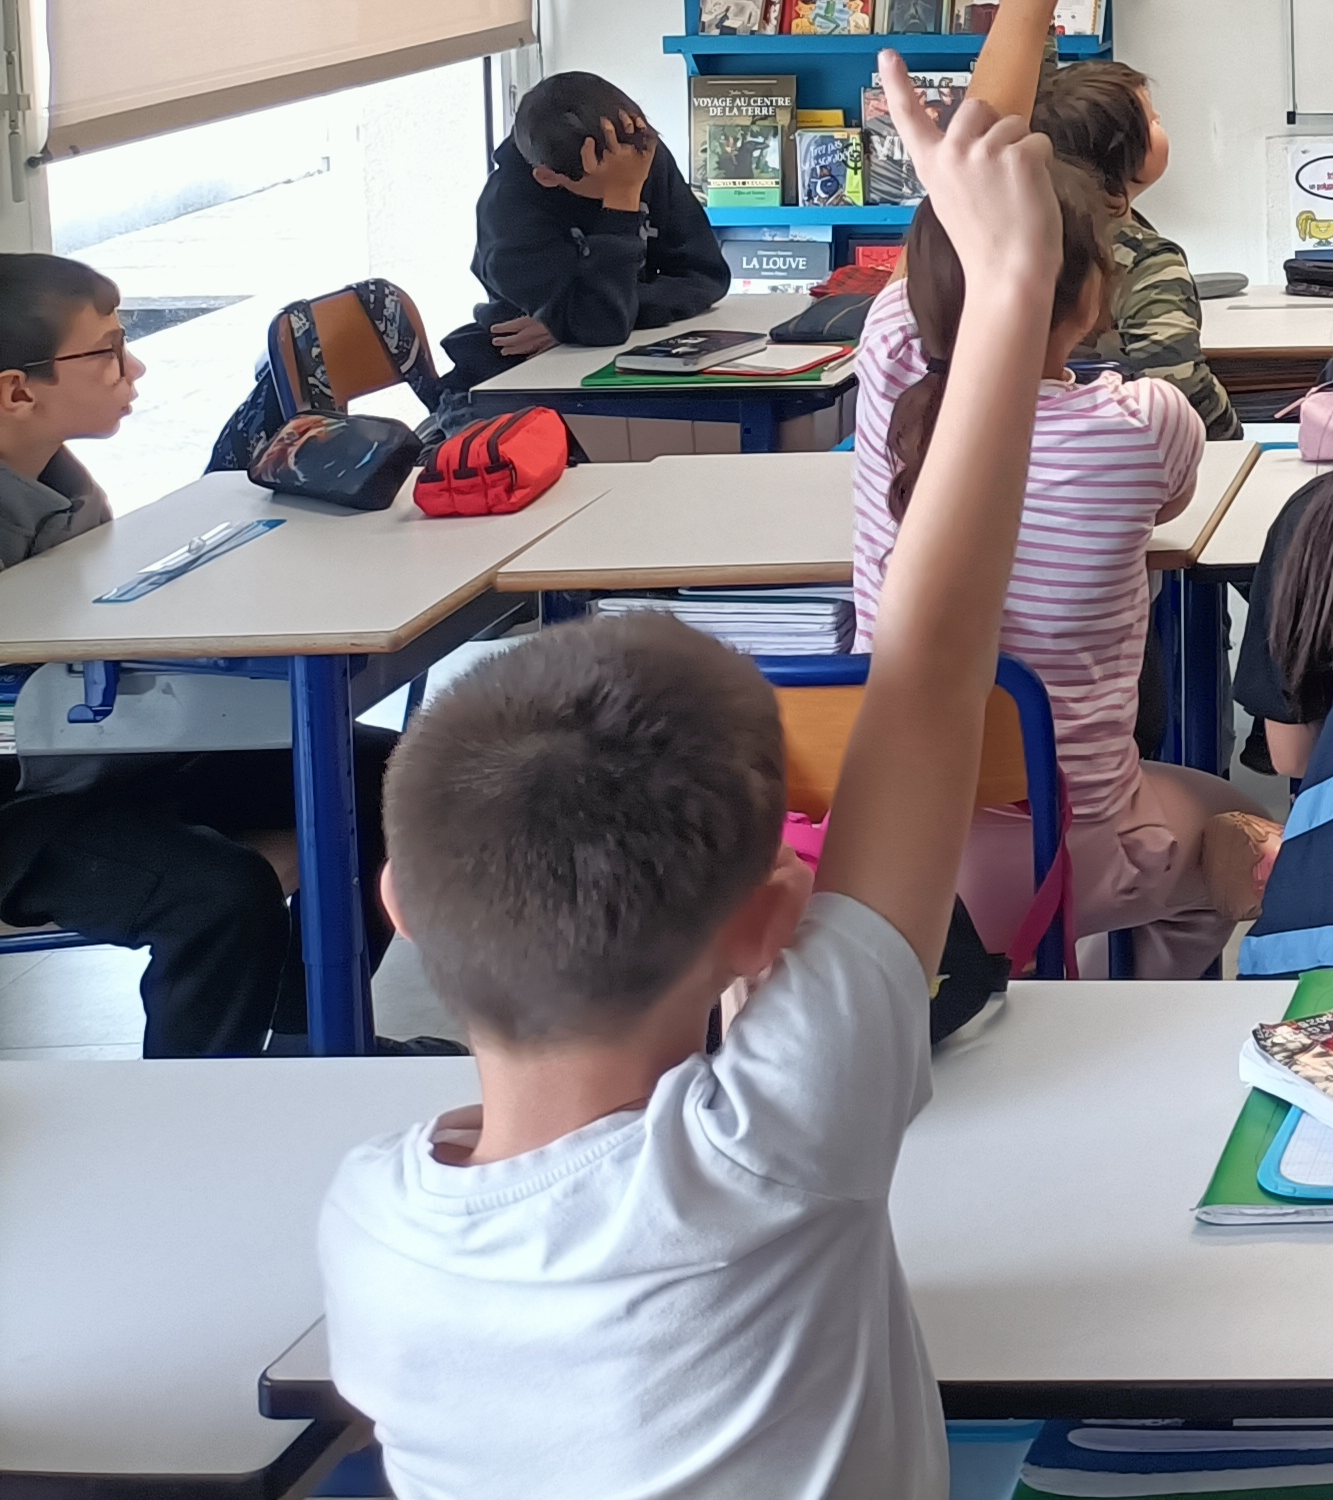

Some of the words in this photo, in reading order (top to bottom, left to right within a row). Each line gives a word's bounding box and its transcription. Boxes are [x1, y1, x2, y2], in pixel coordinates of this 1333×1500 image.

[693, 97, 732, 106] VOYAGE
[734, 97, 749, 106] AU
[750, 97, 791, 106] CENTRE
[709, 107, 723, 116] DE
[725, 107, 740, 116] LA
[741, 106, 775, 116] TERRE
[742, 257, 759, 269] LA
[763, 257, 807, 270] LOUVE
